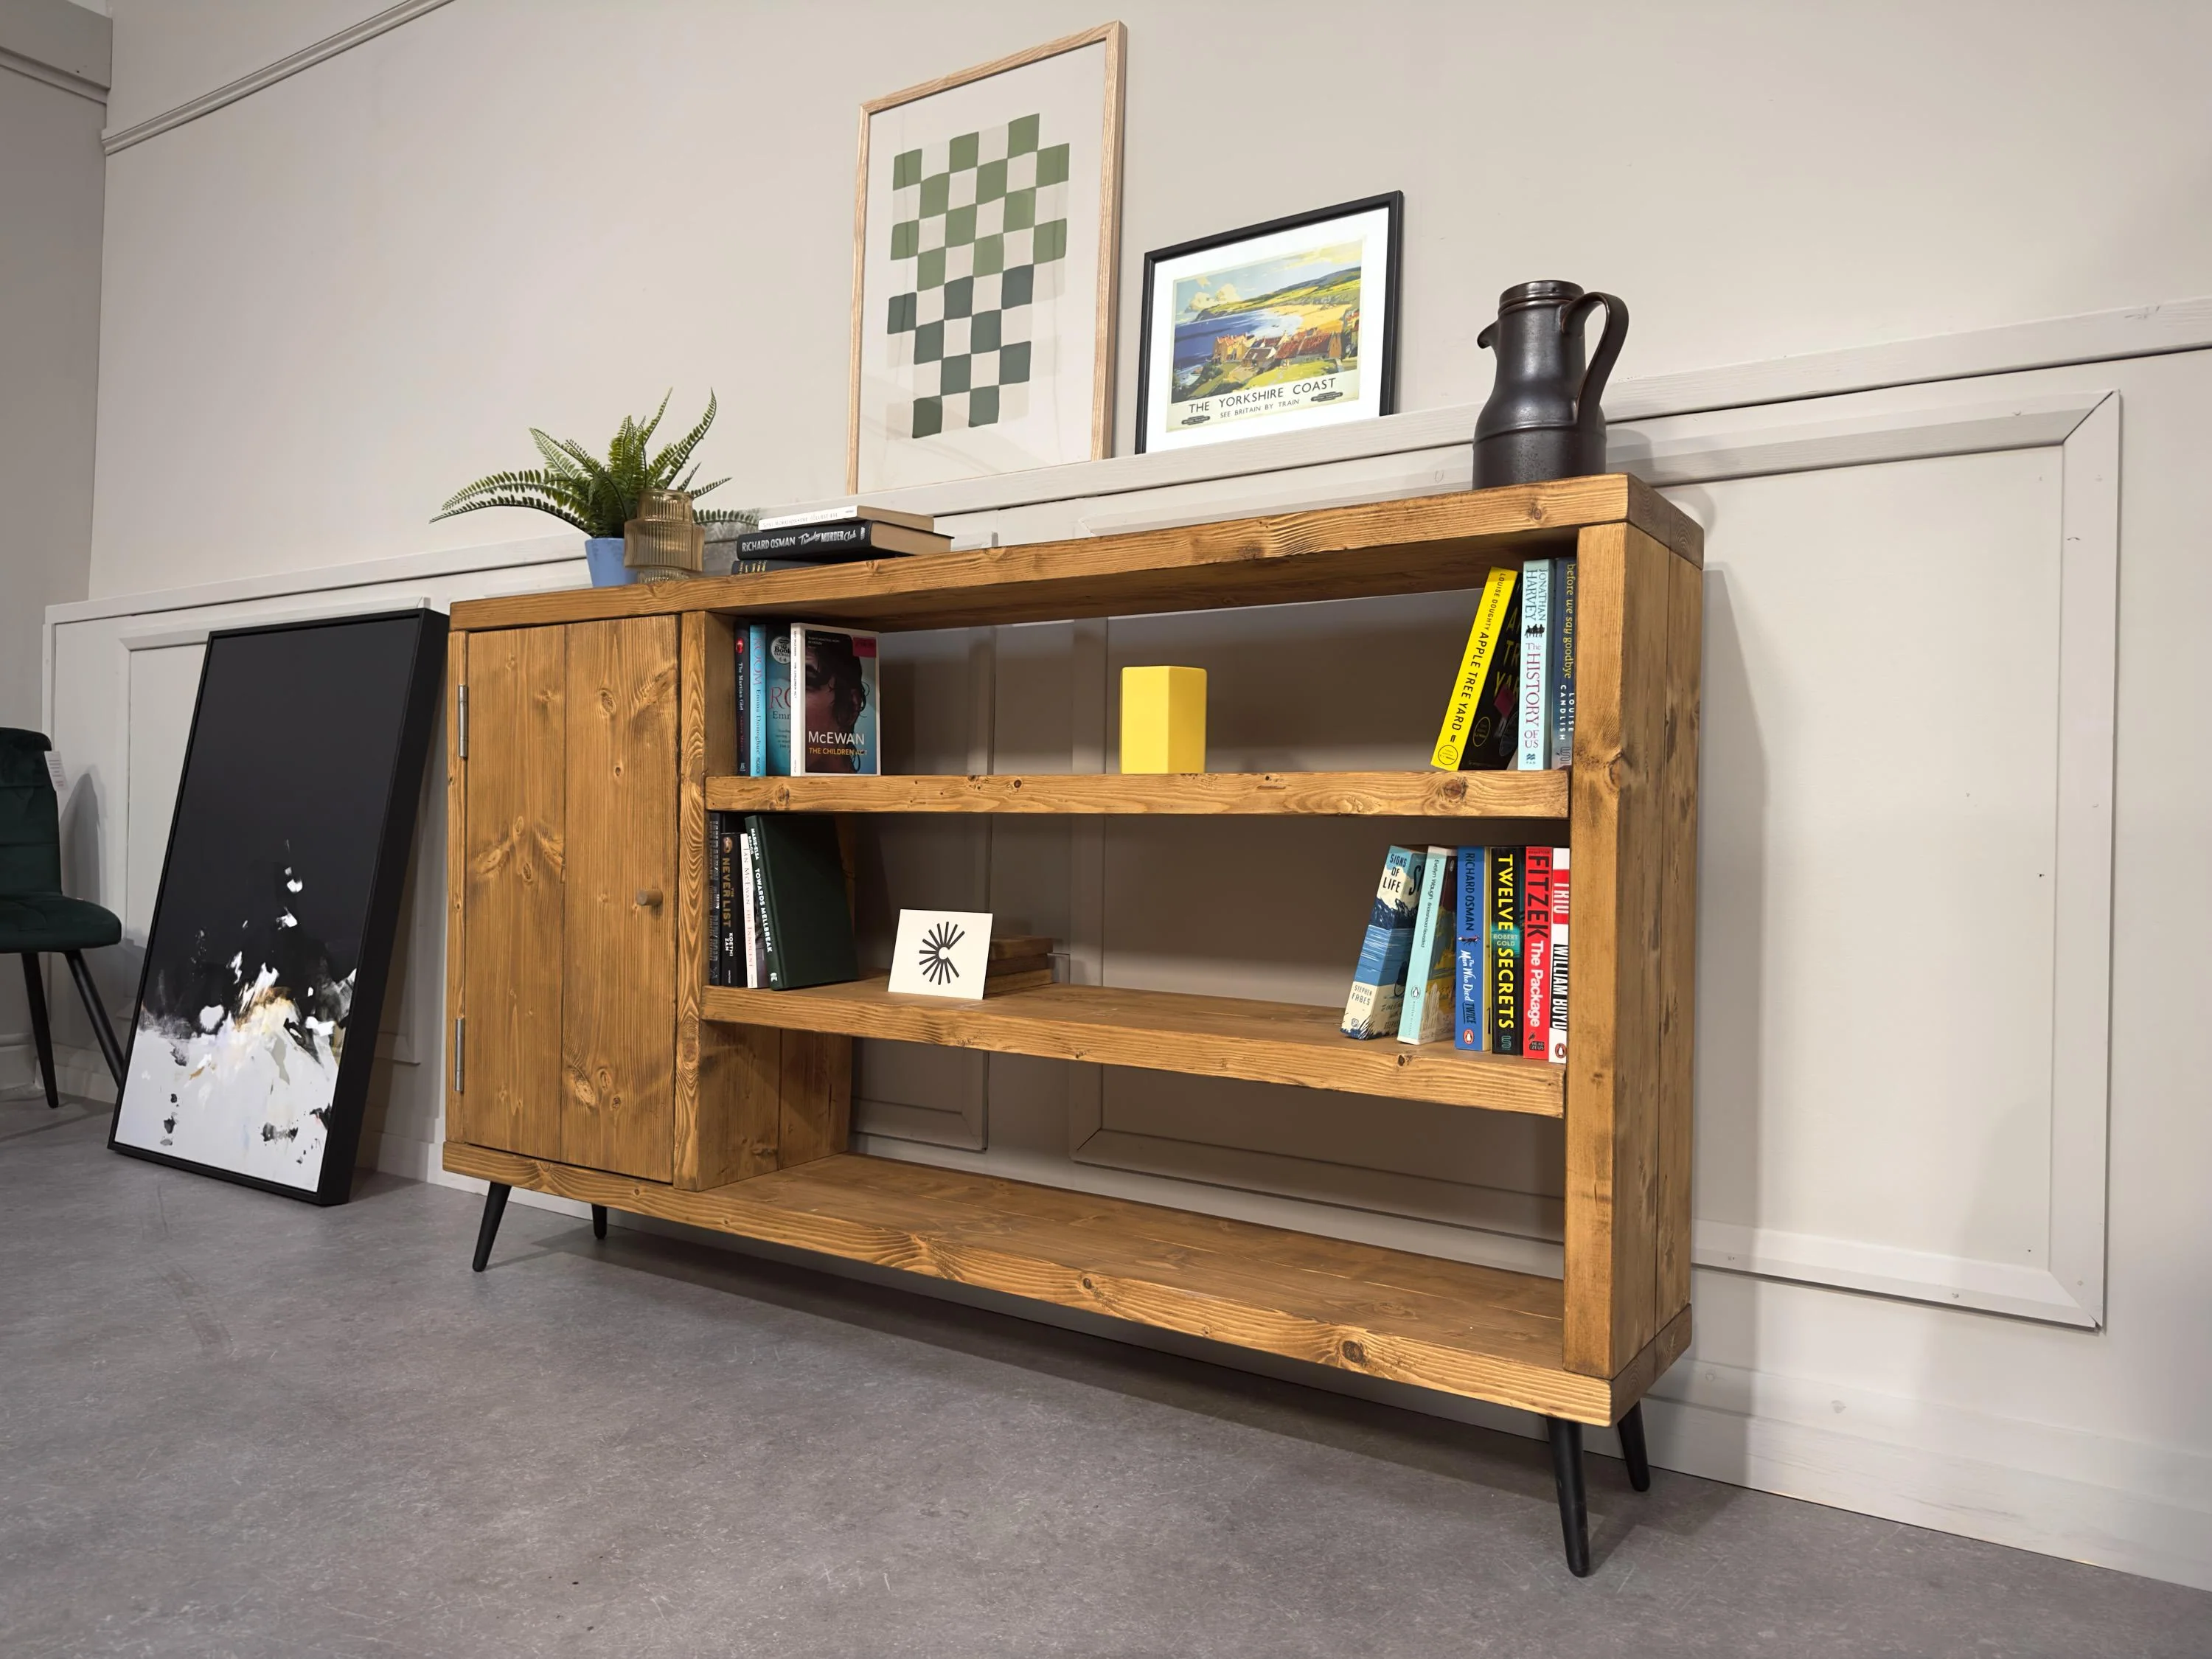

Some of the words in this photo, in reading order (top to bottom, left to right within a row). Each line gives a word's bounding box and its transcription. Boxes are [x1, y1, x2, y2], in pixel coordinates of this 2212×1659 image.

[1189, 402, 1210, 414] THE
[1218, 388, 1284, 407] YORKSHIRE
[1293, 378, 1336, 394] COAST
[1234, 406, 1261, 416] BRITAIN
[1278, 399, 1300, 408] TRAIN
[742, 540, 770, 552] RICHARD
[771, 536, 796, 549] OSMAN
[821, 530, 844, 543] MURDER
[844, 529, 857, 542] Club
[1494, 573, 1506, 597] LOUISE
[1566, 563, 1576, 595] before
[1525, 568, 1538, 622] HARVEY
[1537, 568, 1548, 622] JONATHAN
[1565, 599, 1573, 613] we
[1484, 599, 1498, 630] DOUGHTY
[1563, 617, 1573, 634] say
[753, 638, 762, 686] ROOM
[1470, 632, 1489, 669] APPLE
[1562, 638, 1574, 679] goodbye
[1461, 672, 1478, 700] TREE
[1525, 653, 1540, 726] HISTORY
[1451, 703, 1469, 731] YARD
[808, 731, 865, 745] McEWAN
[1524, 730, 1539, 739] OF
[1525, 740, 1539, 748] US
[822, 748, 855, 756] CHILDREN
[1389, 854, 1408, 868] SIGNS
[1391, 868, 1400, 877] OF
[1465, 852, 1475, 894] RICHARD
[722, 858, 731, 897] NEVER
[1382, 877, 1402, 893] LIFE
[1427, 879, 1437, 900] Waugh
[1498, 853, 1514, 931] TWELVE
[1527, 855, 1550, 939] FITZEK
[723, 900, 731, 928] LIST
[755, 868, 765, 906] TOWARDS
[760, 907, 773, 953] MELLBREAK
[1465, 895, 1475, 931] OSMAN
[1458, 949, 1471, 967] Man
[1531, 940, 1544, 966] The
[1462, 967, 1476, 983] Who
[1553, 945, 1569, 995] WILLIAM
[1351, 992, 1371, 1006] FABES
[1354, 984, 1372, 996] STEPHEN
[1463, 984, 1475, 1002] Died
[1498, 947, 1514, 1029] SECRETS
[1527, 969, 1544, 1027] Package
[1464, 1003, 1476, 1024] TWICE
